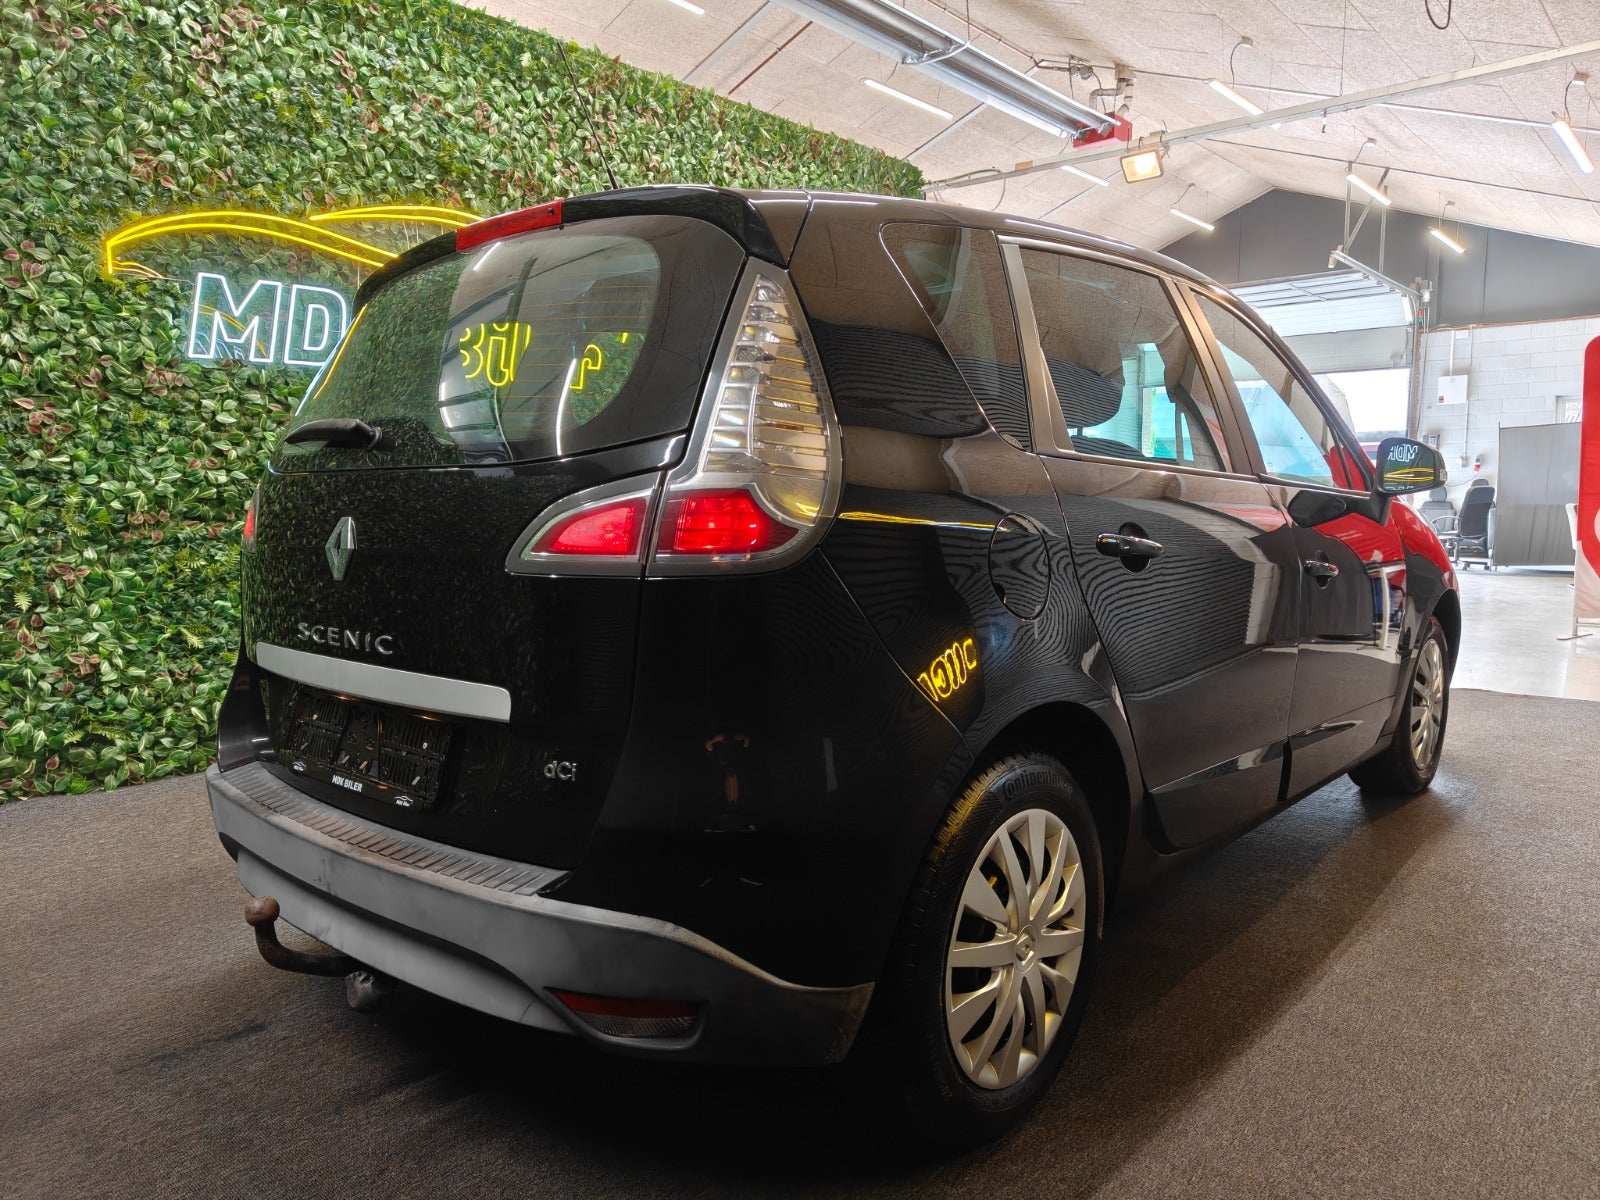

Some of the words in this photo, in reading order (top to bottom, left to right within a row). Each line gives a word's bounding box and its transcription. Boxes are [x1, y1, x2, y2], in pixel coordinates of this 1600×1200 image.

[297, 622, 393, 655] SCENIC
[543, 760, 577, 782] dCi
[344, 779, 362, 792] BILER
